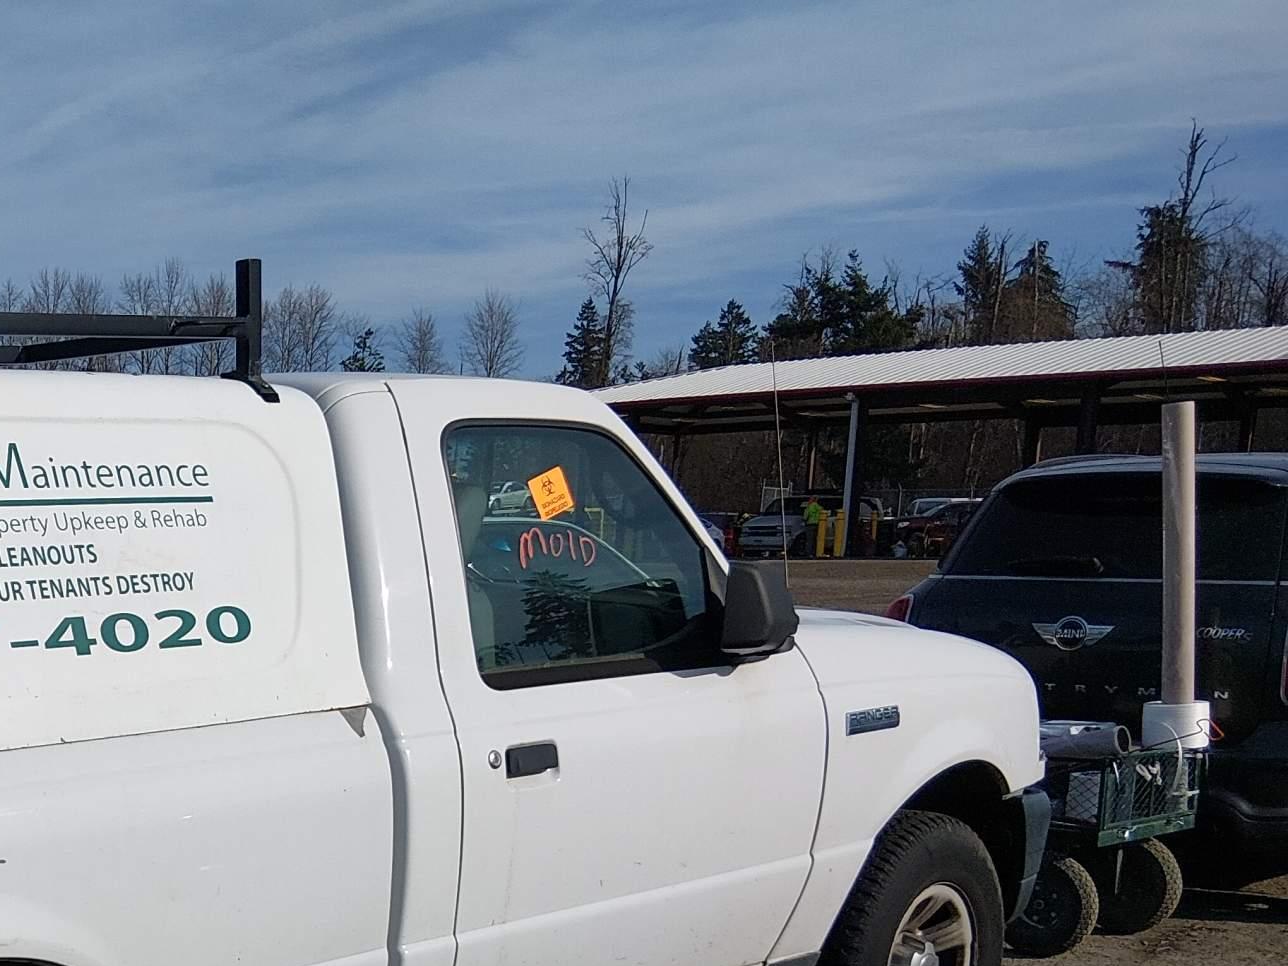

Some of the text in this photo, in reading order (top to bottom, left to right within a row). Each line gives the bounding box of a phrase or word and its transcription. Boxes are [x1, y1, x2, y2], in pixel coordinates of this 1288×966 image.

[53, 510, 129, 534] Upkeep
[133, 510, 148, 529] &
[150, 508, 207, 528] Rehab
[26, 576, 113, 600] TENANTS
[116, 572, 194, 595] DESTROY
[1196, 626, 1246, 640] COOPER
[1044, 682, 1229, 700] TRYMN
